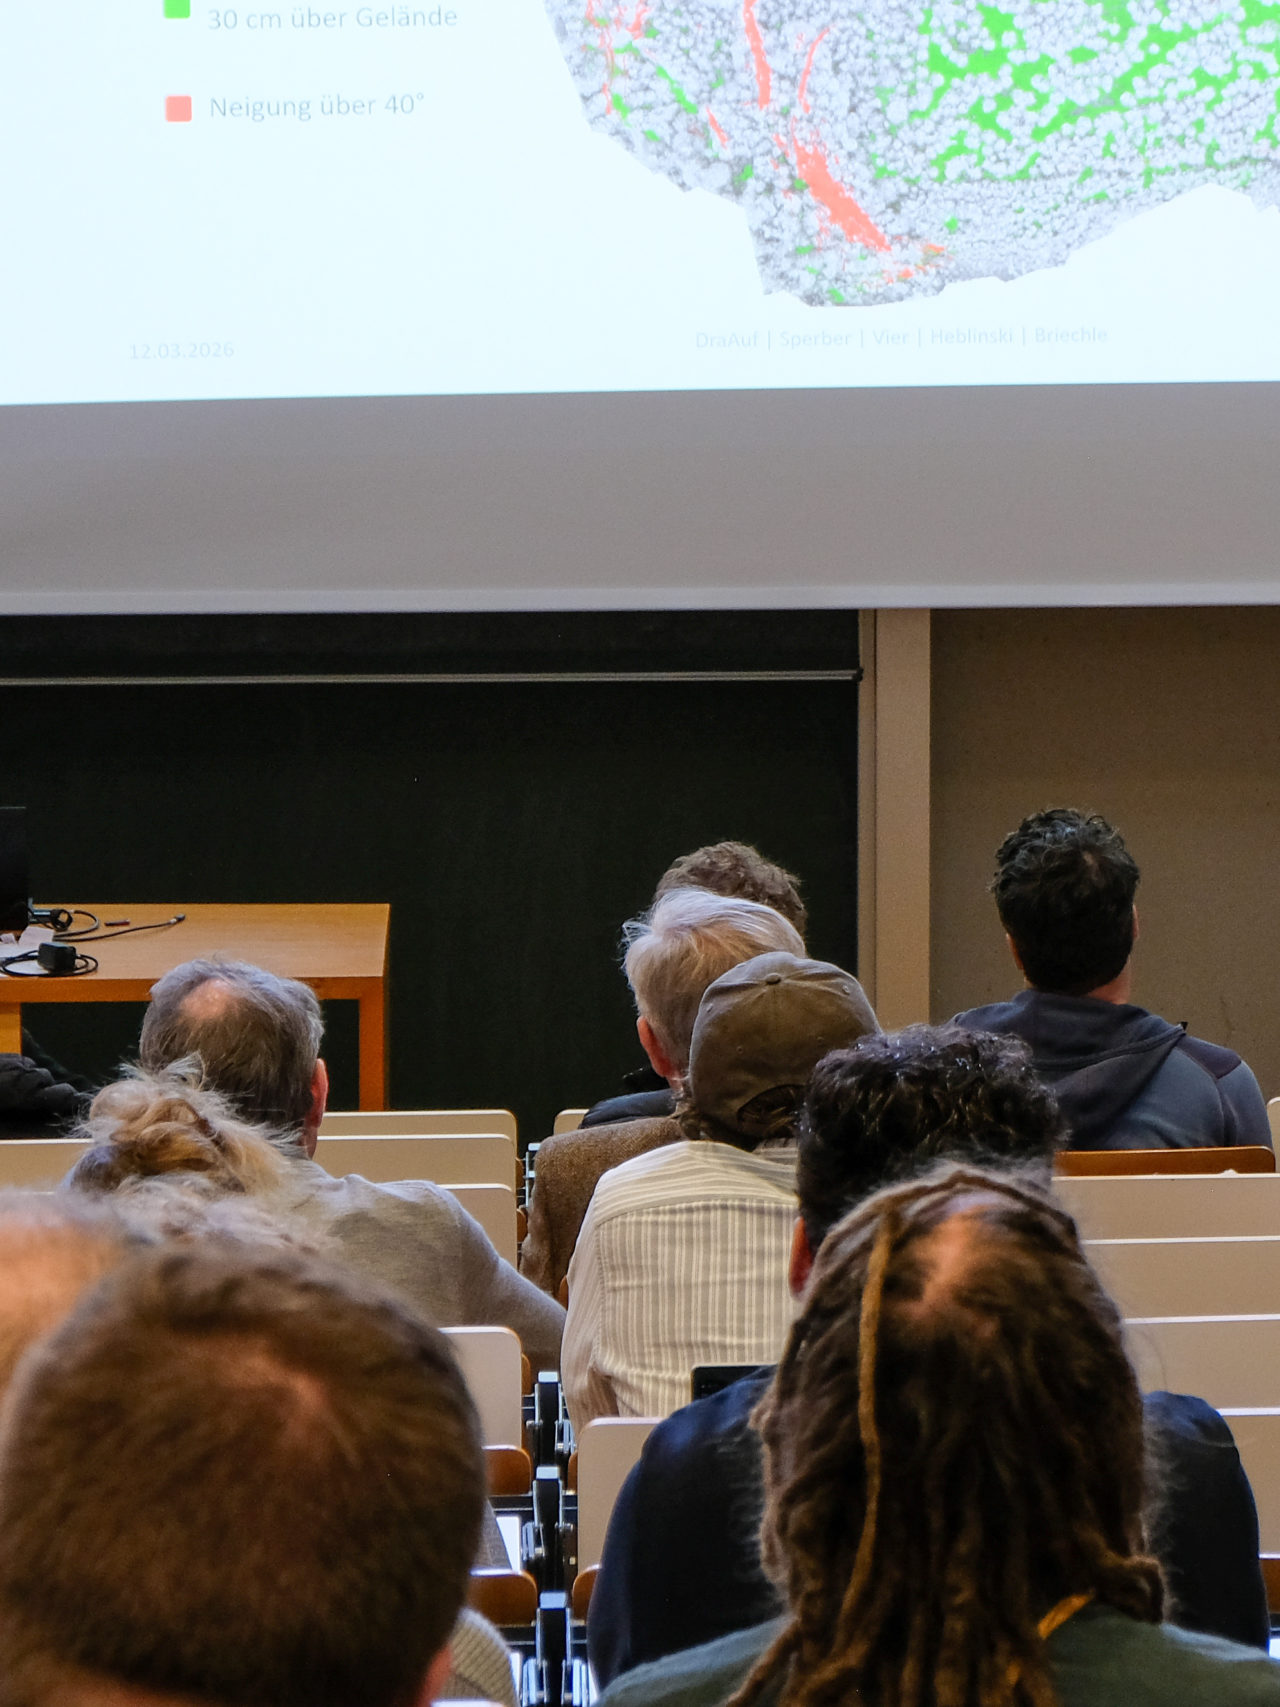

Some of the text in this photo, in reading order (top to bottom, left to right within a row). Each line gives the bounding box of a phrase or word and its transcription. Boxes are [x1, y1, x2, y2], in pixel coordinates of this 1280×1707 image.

[207, 5, 458, 30] 30 cm über Gelände
[209, 92, 425, 122] Neigung über 40°
[695, 330, 759, 348] DraAuf
[779, 330, 852, 350] Sperber
[872, 329, 911, 345] Vier
[1034, 326, 1109, 344] Briechle
[130, 342, 235, 360] 12.03.2026
